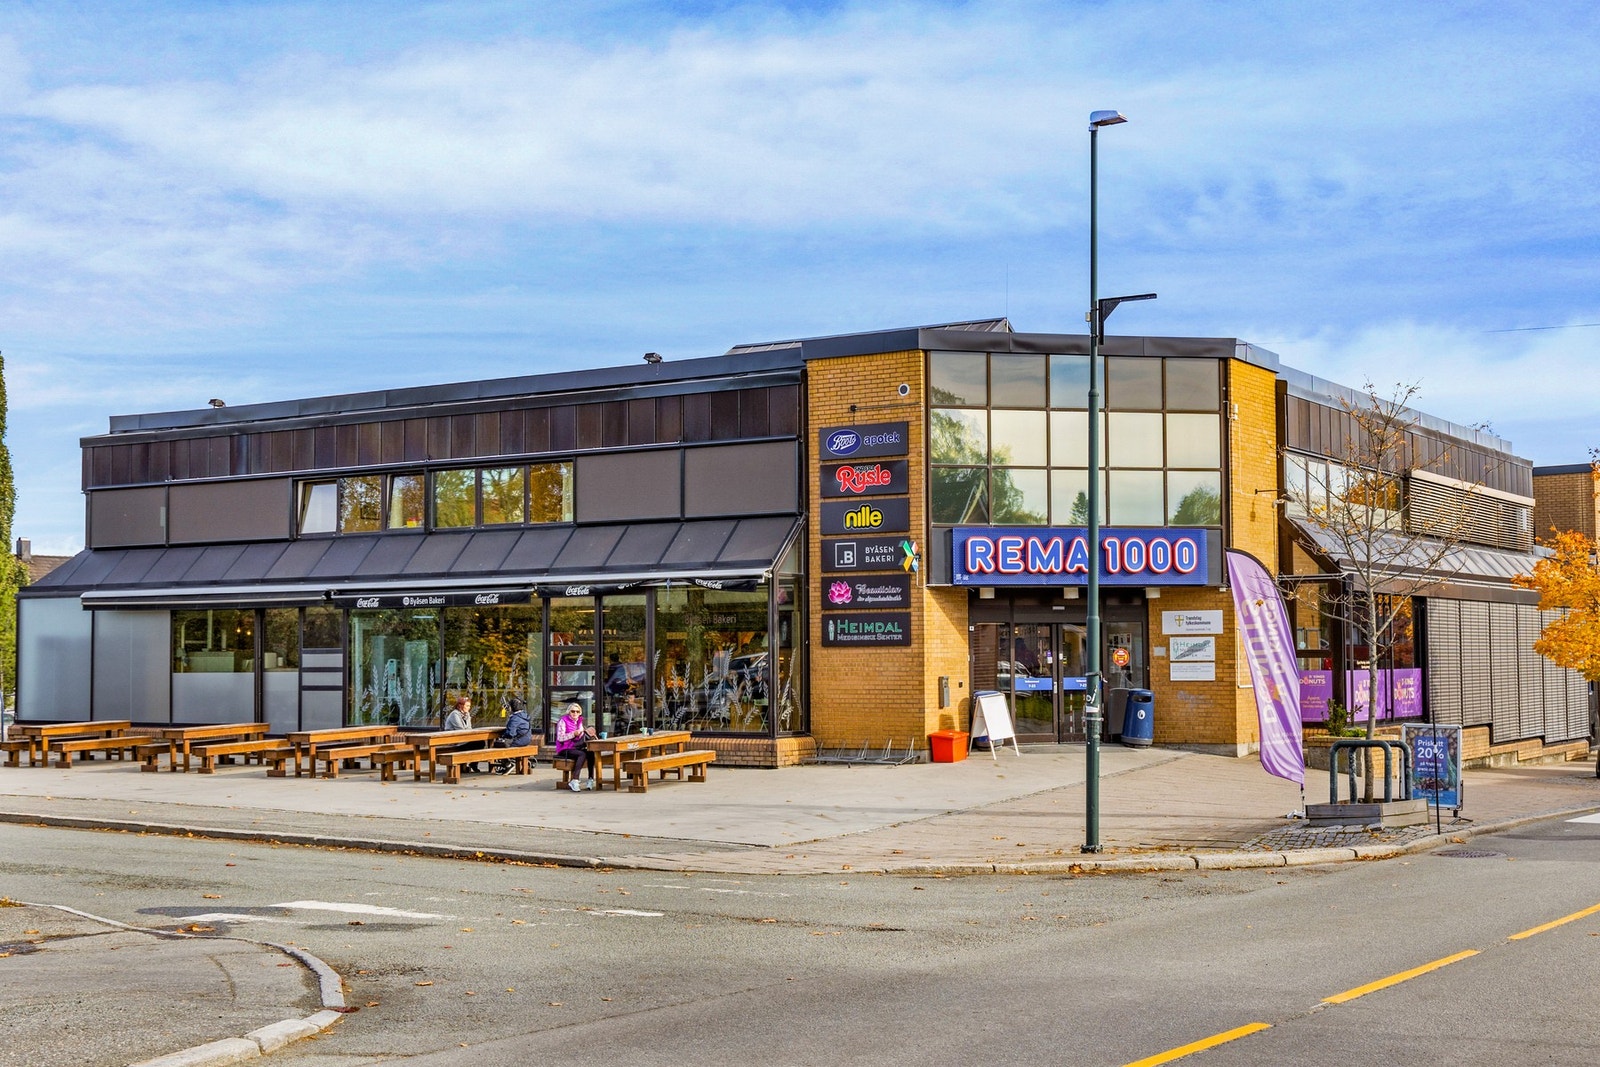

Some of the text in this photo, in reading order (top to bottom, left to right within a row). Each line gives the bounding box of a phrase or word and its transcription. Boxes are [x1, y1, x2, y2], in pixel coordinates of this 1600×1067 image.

[863, 432, 900, 446] apotek
[844, 503, 884, 530] nille
[865, 545, 894, 554] BYÅSEN
[965, 536, 1199, 574] REMA 1000
[865, 555, 894, 563] BAKERI
[428, 596, 446, 605] Bakeri
[837, 619, 902, 634] HEIMDAL
